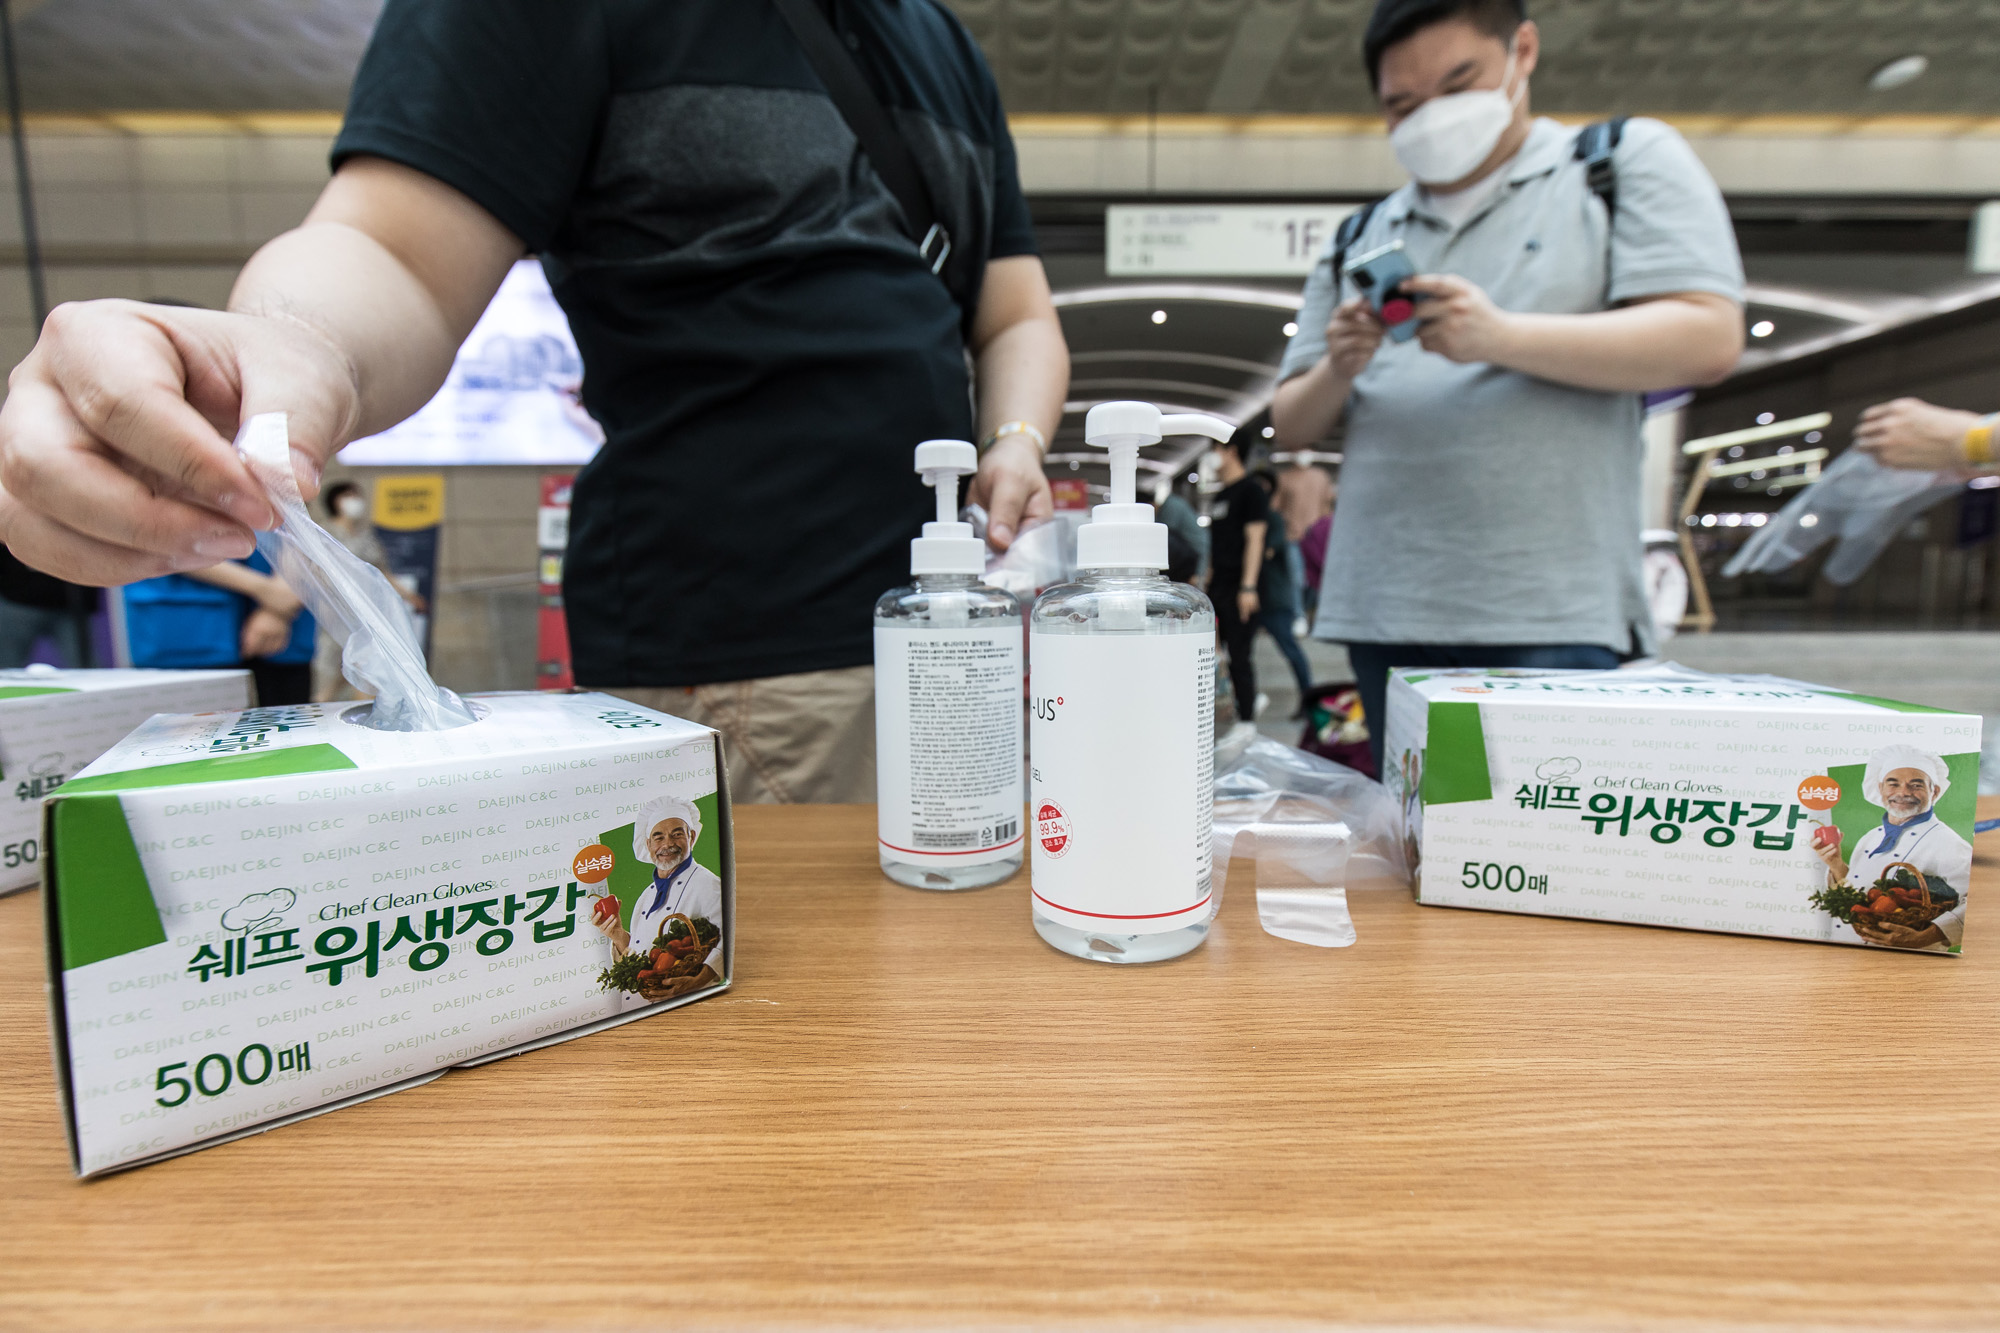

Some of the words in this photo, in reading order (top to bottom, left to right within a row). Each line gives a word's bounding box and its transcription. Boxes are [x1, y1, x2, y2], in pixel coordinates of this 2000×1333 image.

[1512, 713, 1548, 724] DAEJIN
[1590, 715, 1627, 726] DAEJIN
[1672, 718, 1711, 729] DAEJIN
[1758, 721, 1800, 732] DAEJIN
[1848, 723, 1893, 735] DAEJIN
[1553, 736, 1590, 747] DAEJIN
[1633, 739, 1672, 751] DAEJIN
[1717, 742, 1758, 754] DAEJIN
[614, 751, 653, 763] DAEJIN
[656, 747, 680, 758] C&C
[1805, 746, 1849, 757] DAEJIN
[523, 762, 567, 775] DAEJIN
[571, 758, 598, 769] C&C
[1588, 759, 1626, 771] DAEJIN
[1670, 763, 1710, 775] DAEJIN
[1756, 767, 1797, 779] DAEJIN
[418, 773, 469, 787] DAEJIN
[474, 769, 505, 780] C&C
[659, 770, 695, 782] DAEJIN
[1593, 775, 1629, 789] Chef
[1630, 777, 1670, 791] Clean
[1674, 779, 1723, 793] Gloves
[299, 785, 357, 800] DAEJIN
[362, 780, 398, 793] C&C
[575, 782, 616, 795] DAEJIN
[619, 777, 645, 788] C&C
[1799, 786, 1839, 802] 실속형
[478, 794, 525, 808] DAEJIN
[529, 789, 558, 801] C&C
[367, 808, 421, 823] DAEJIN
[426, 803, 459, 815] C&C
[526, 815, 570, 829] DAEJIN
[574, 810, 601, 821] C&C
[1514, 784, 1582, 810] 쉐프
[1581, 793, 1808, 851] 위생장갑
[241, 823, 302, 839] DAEJIN
[308, 817, 346, 831] C&C
[423, 830, 473, 845] DAEJIN
[478, 824, 509, 836] C&C
[304, 846, 362, 863] DAEJIN
[367, 840, 402, 853] C&C
[482, 848, 528, 864] DAEJIN
[532, 842, 561, 855] C&C
[372, 866, 425, 882] DAEJIN
[430, 859, 463, 872] C&C
[574, 853, 613, 876] 실속형
[313, 877, 350, 892] C&C
[1462, 861, 1548, 895] 500매
[319, 897, 369, 921] Chef
[372, 891, 427, 912] Clean
[433, 880, 493, 900] Gloves
[187, 928, 305, 982] 쉐프
[305, 881, 587, 986] 위생장갑
[488, 953, 534, 971] DAEJIN
[538, 945, 566, 959] C&C
[380, 977, 432, 997] DAEJIN
[437, 968, 469, 983] C&C
[534, 967, 577, 986] DAEJIN
[433, 992, 482, 1012] DAEJIN
[487, 983, 517, 998] C&C
[257, 1004, 317, 1026] DAEJIN
[322, 994, 359, 1011] C&C
[490, 1004, 536, 1023] DAEJIN
[540, 995, 568, 1009] C&C
[318, 1019, 374, 1041] DAEJIN
[379, 1009, 414, 1025] C&C
[536, 1016, 579, 1036] DAEJIN
[583, 1007, 609, 1021] C&C
[383, 1031, 435, 1053] DAEJIN
[440, 1021, 472, 1037] C&C
[436, 1044, 485, 1065] DAEJIN
[489, 1034, 519, 1049] C&C
[326, 1051, 362, 1068] C&C
[155, 1041, 311, 1108] 500매
[322, 1075, 377, 1098] DAEJIN
[382, 1064, 416, 1080] C&C
